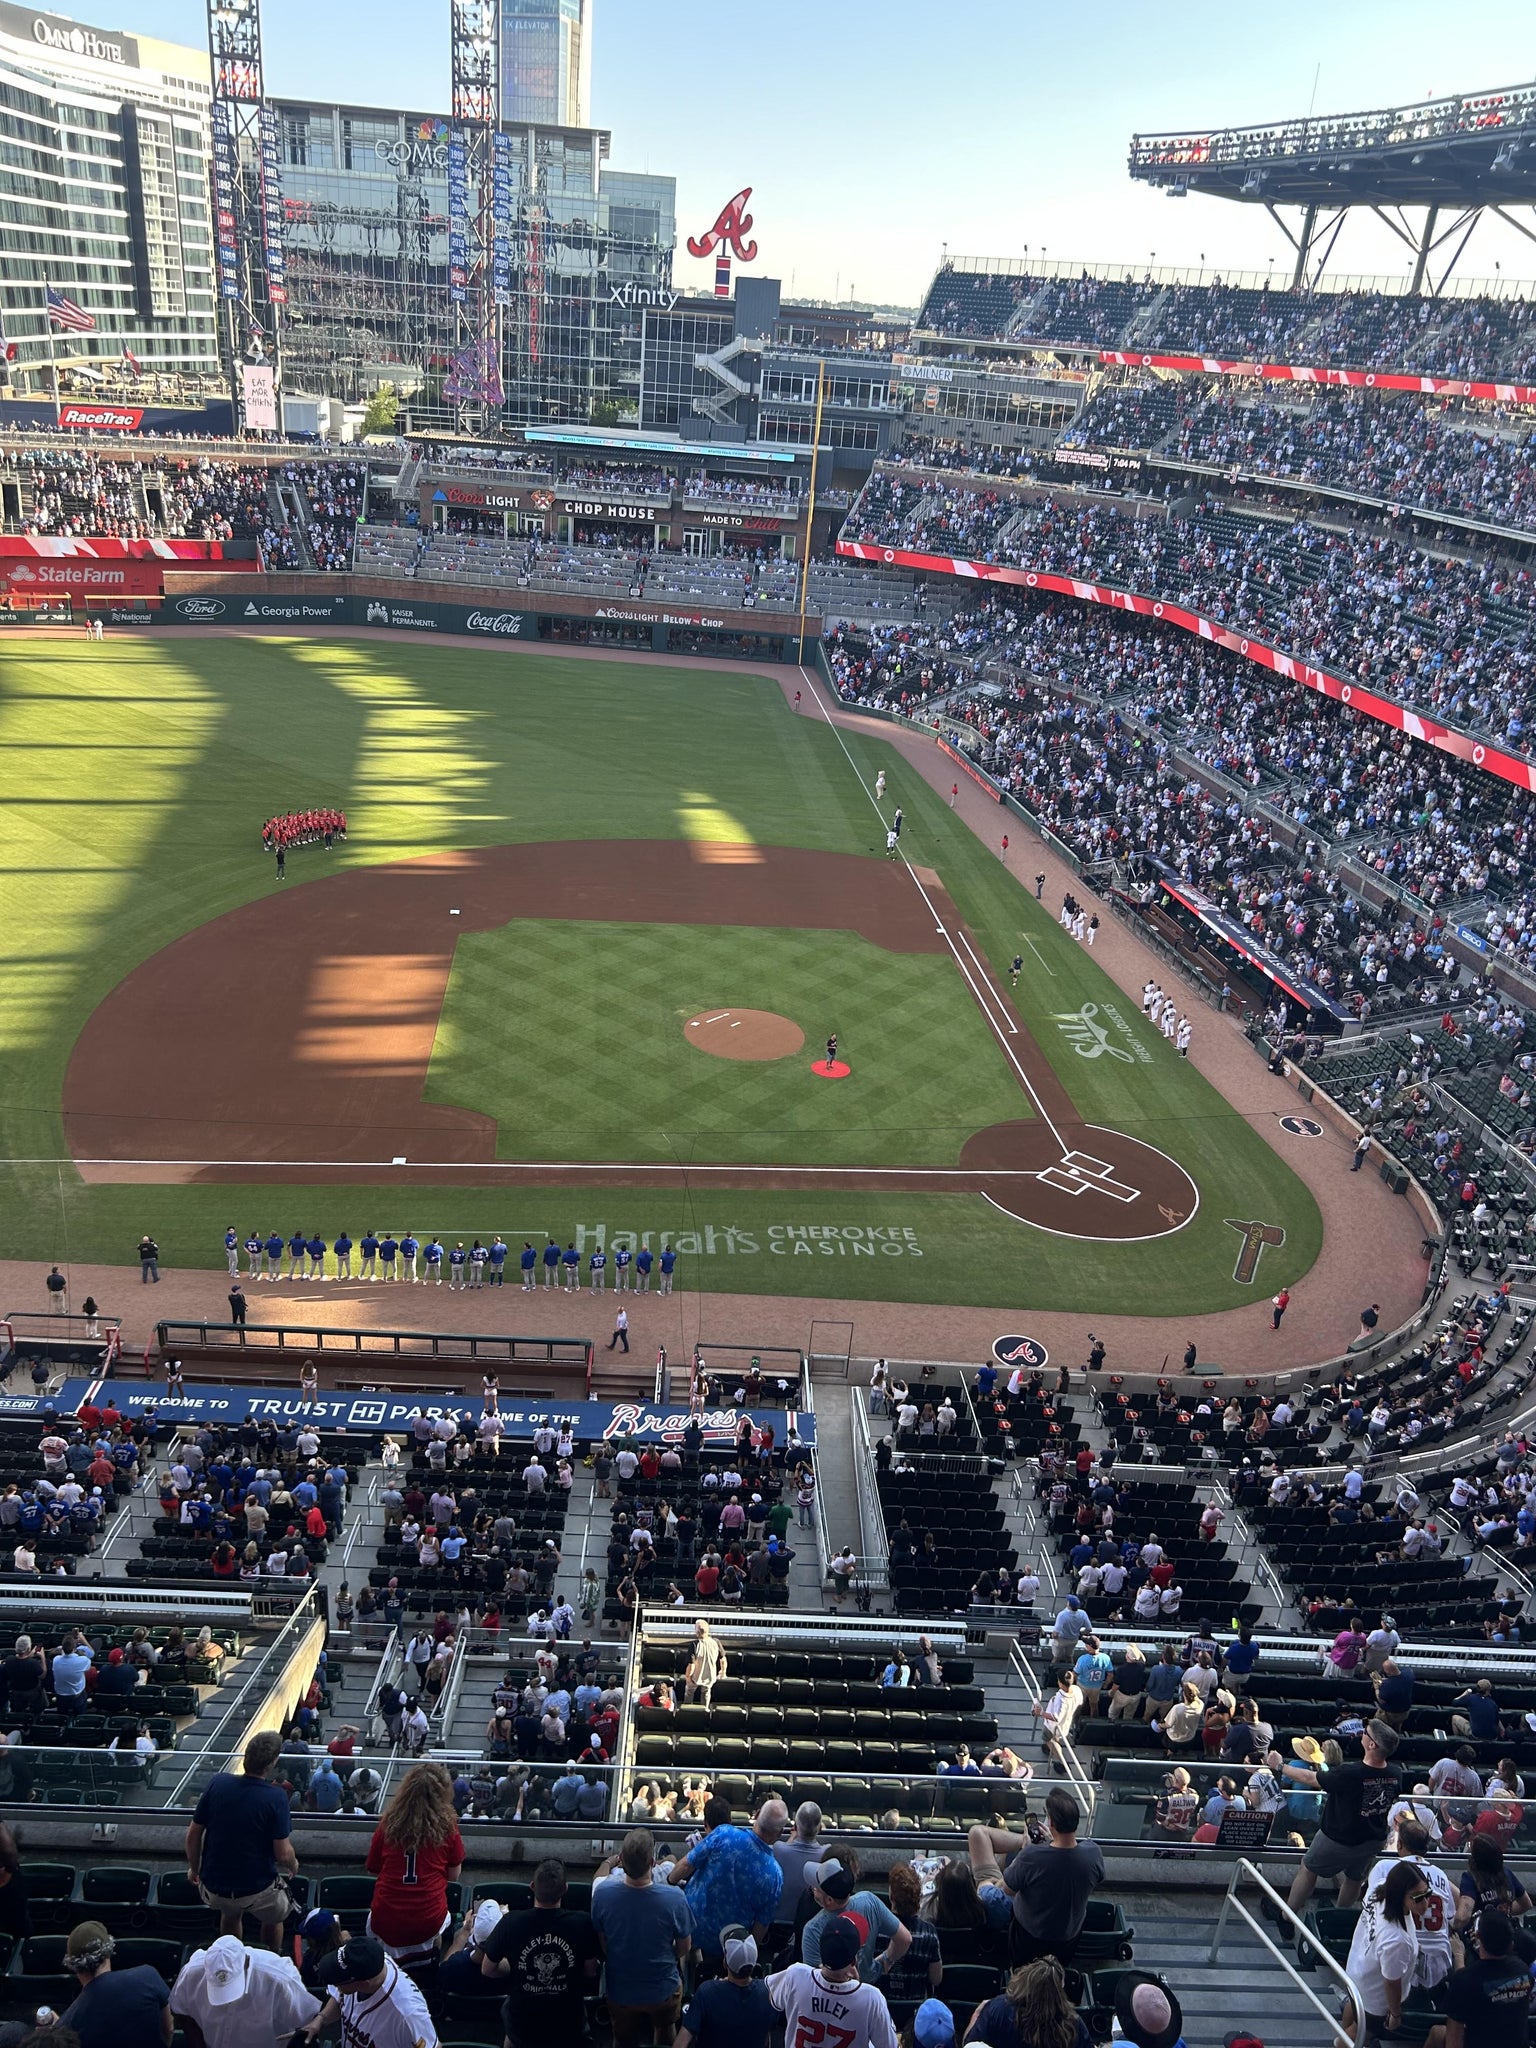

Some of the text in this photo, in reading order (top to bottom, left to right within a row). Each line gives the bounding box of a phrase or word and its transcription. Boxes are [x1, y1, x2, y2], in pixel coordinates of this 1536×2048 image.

[504, 20, 550, 30] TK ELEVATOR
[34, 18, 126, 64] OMNI HOTEL
[611, 282, 680, 312] xfinity
[912, 367, 951, 381] MILNER
[252, 379, 266, 387] EAT
[252, 388, 268, 397] MOR
[247, 397, 272, 407] CHIKIN
[65, 410, 134, 426] RaceTrac
[1113, 458, 1128, 468] 7:04
[1129, 460, 1141, 470] PM
[448, 488, 520, 507] Coors LIGHT
[565, 502, 655, 520] CHOP HOUSE
[703, 515, 729, 525] MADE
[730, 517, 743, 526] TO
[184, 599, 217, 614] Ford
[261, 606, 333, 618] Georgia Power
[392, 609, 413, 618] KAISER
[121, 613, 152, 621] National
[467, 611, 524, 634] Coca-Cola
[606, 607, 634, 620] Coors
[634, 612, 658, 622] LIGHT
[663, 614, 692, 625] BELOW
[701, 618, 724, 628] CHOP
[767, 1225, 917, 1241] CHEROKEE
[769, 1241, 924, 1256] CASINOS
[128, 1396, 205, 1408] WELCOME
[210, 1400, 229, 1409] TO
[248, 1399, 347, 1417] TRUIST
[390, 1405, 463, 1422] PARK
[528, 1413, 549, 1423] OF
[553, 1414, 581, 1424] THE
[602, 1403, 737, 1440] Braves
[561, 1435, 571, 1443] 27
[538, 1657, 552, 1668] 44
[1089, 1670, 1101, 1681] 13
[1172, 1799, 1195, 1808] BALDWIN
[1229, 1812, 1268, 1820] CAUTION
[403, 1850, 418, 1884] 1
[1435, 1874, 1447, 1893] JR
[518, 1933, 575, 1970] HARLEY-DAVIDSON
[811, 1996, 850, 2020] RILEY
[795, 2015, 857, 2048] 27
